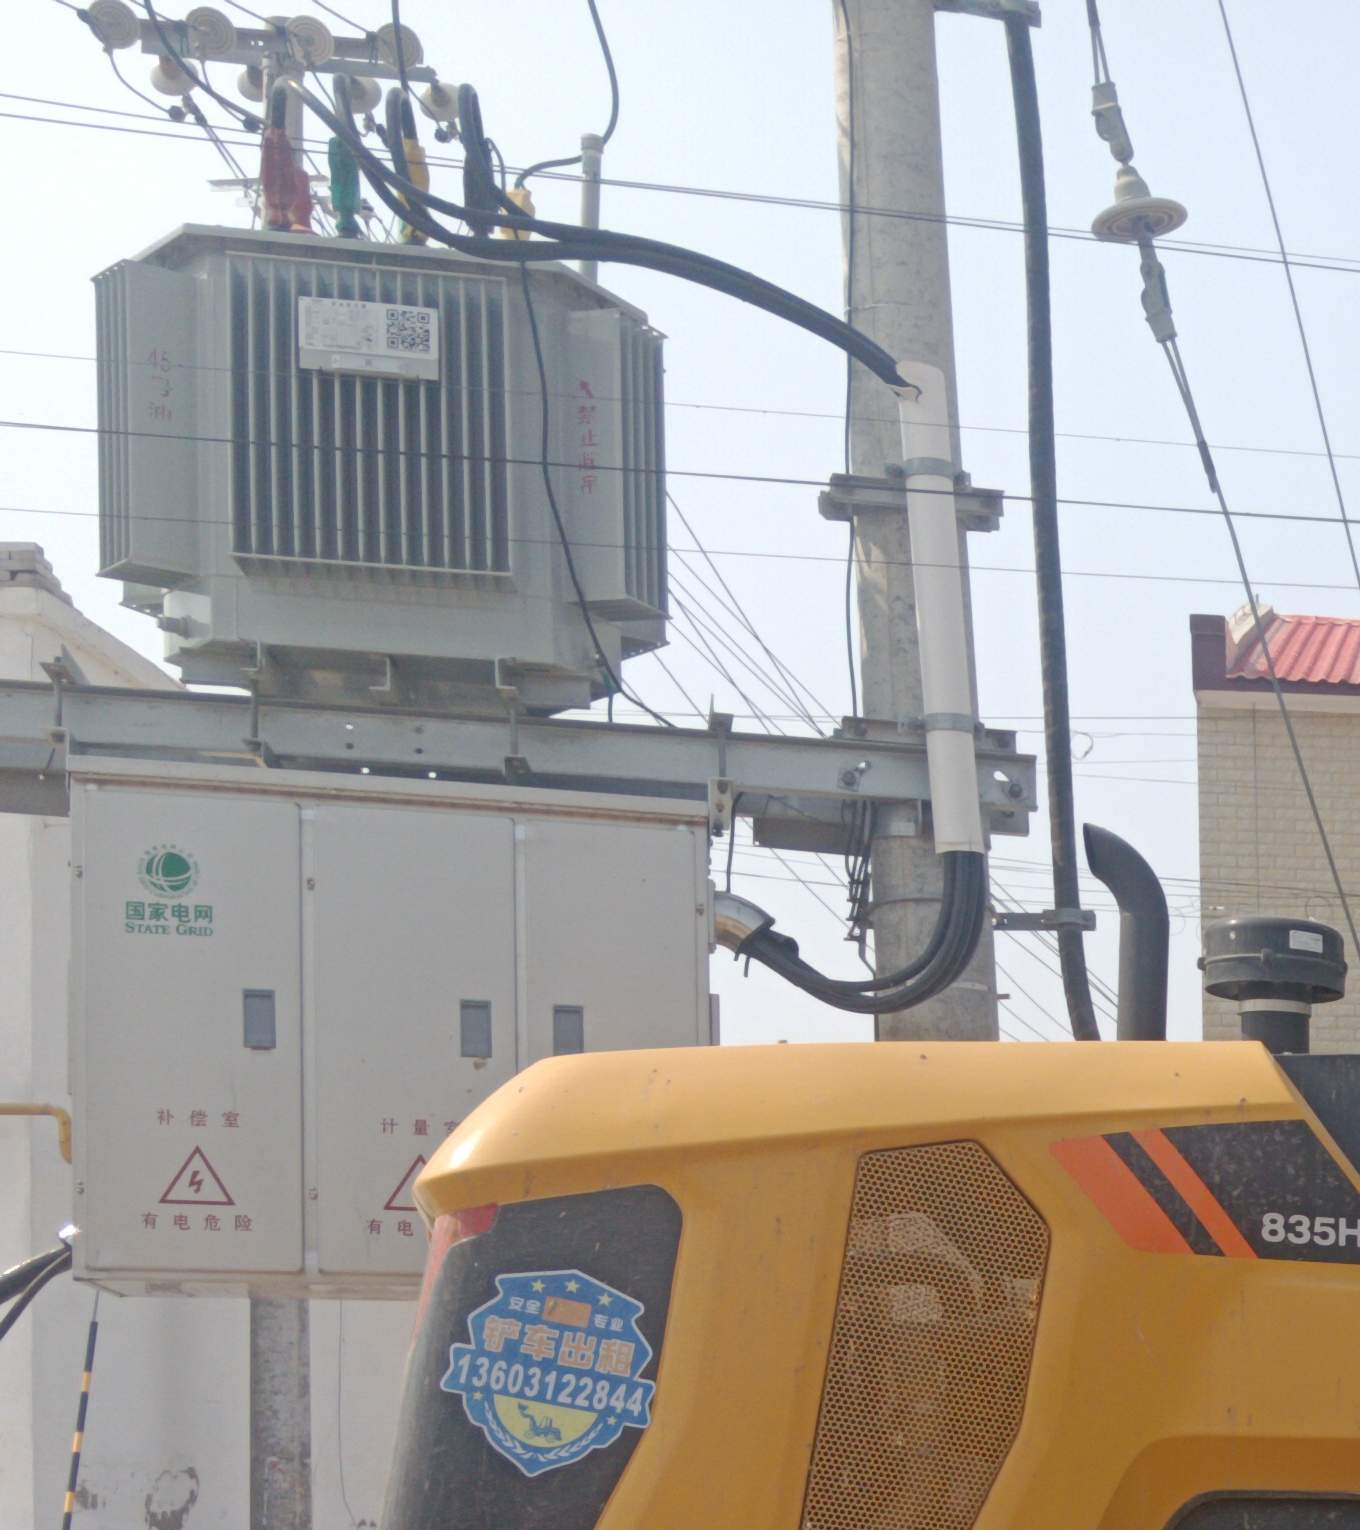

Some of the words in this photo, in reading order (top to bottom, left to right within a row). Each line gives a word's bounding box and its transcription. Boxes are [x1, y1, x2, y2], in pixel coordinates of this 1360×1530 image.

[126, 901, 213, 924] 国家电网
[176, 924, 214, 937] GRID
[157, 1109, 240, 1128] 补偿室
[141, 1212, 252, 1232] 有电危险
[483, 1315, 635, 1378] 铲车出租
[457, 1354, 644, 1416] 13603122844
